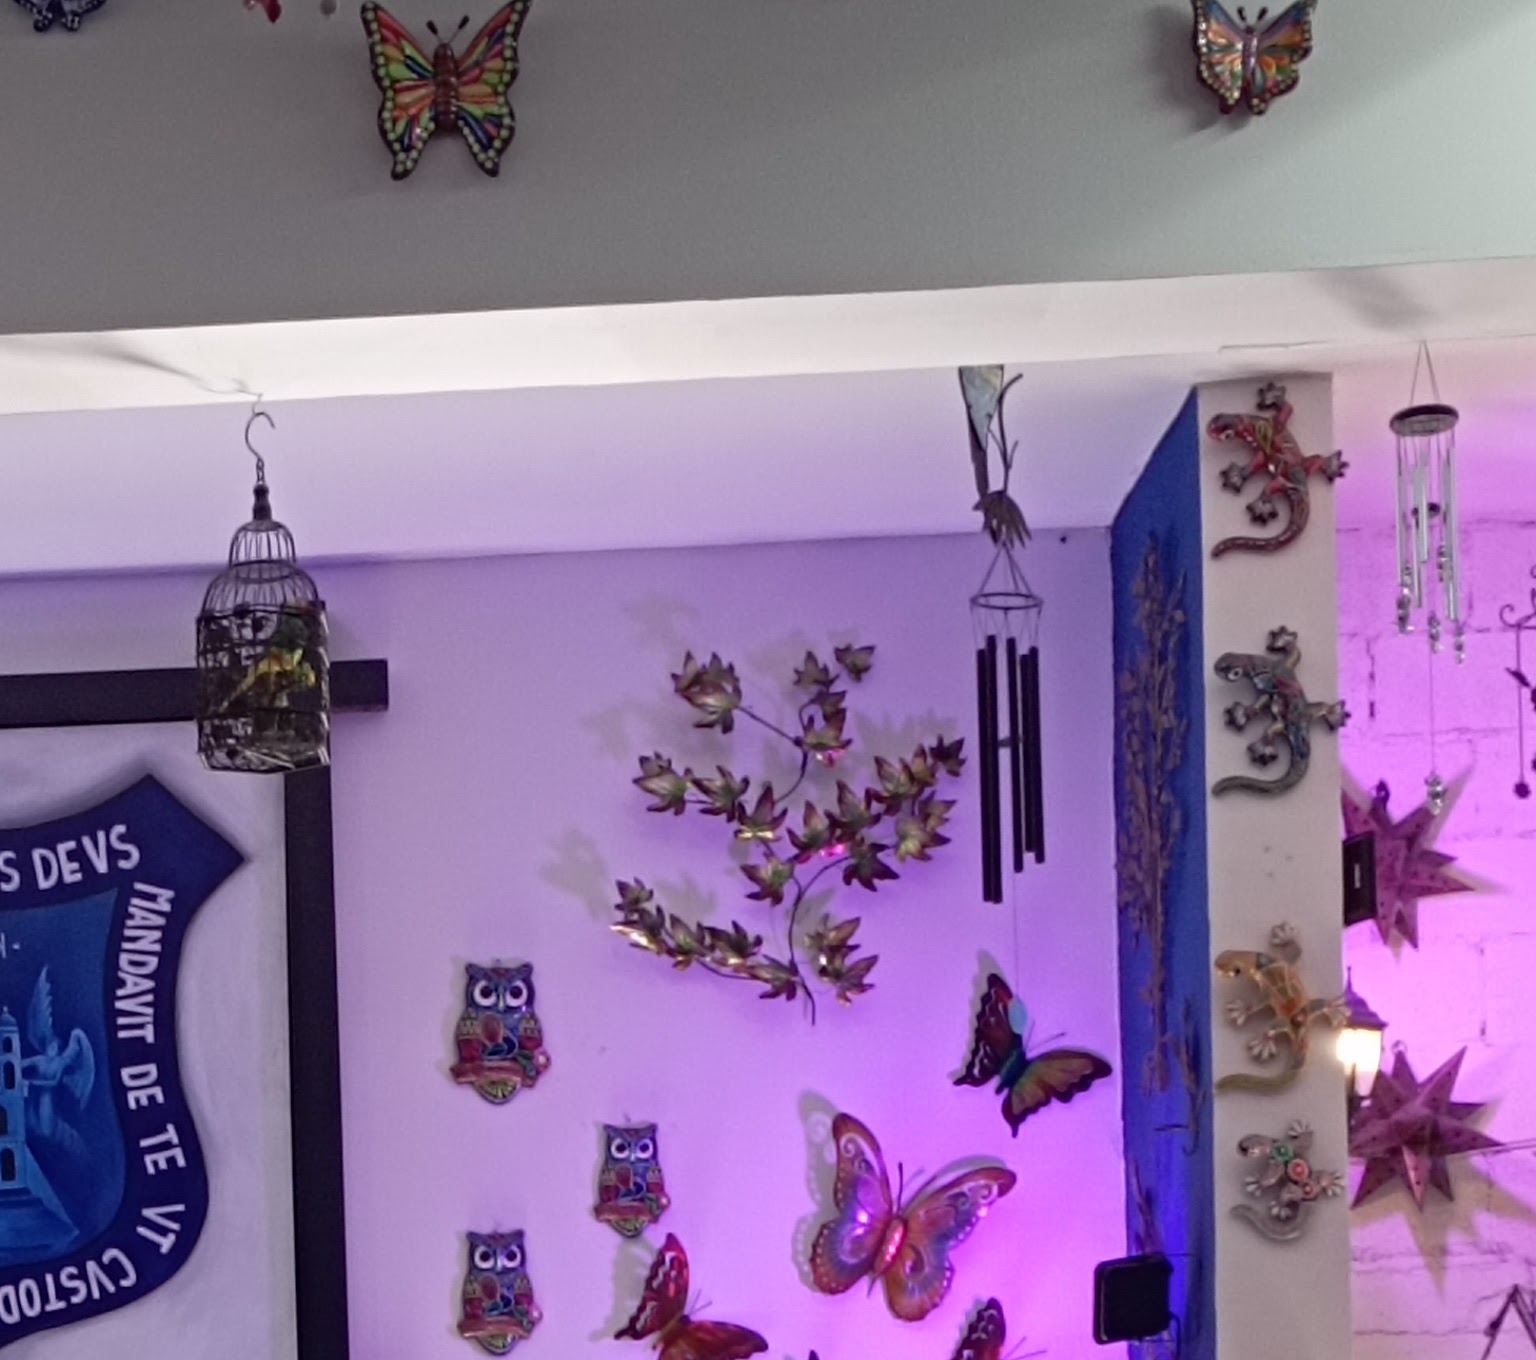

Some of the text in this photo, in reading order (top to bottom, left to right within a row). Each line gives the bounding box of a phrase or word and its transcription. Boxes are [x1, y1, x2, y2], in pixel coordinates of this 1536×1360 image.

[32, 824, 140, 889] DEVS
[114, 881, 176, 1044] MANDAVIT
[120, 1062, 165, 1111] DE
[139, 1123, 186, 1175] TE
[135, 1203, 186, 1255] VT
